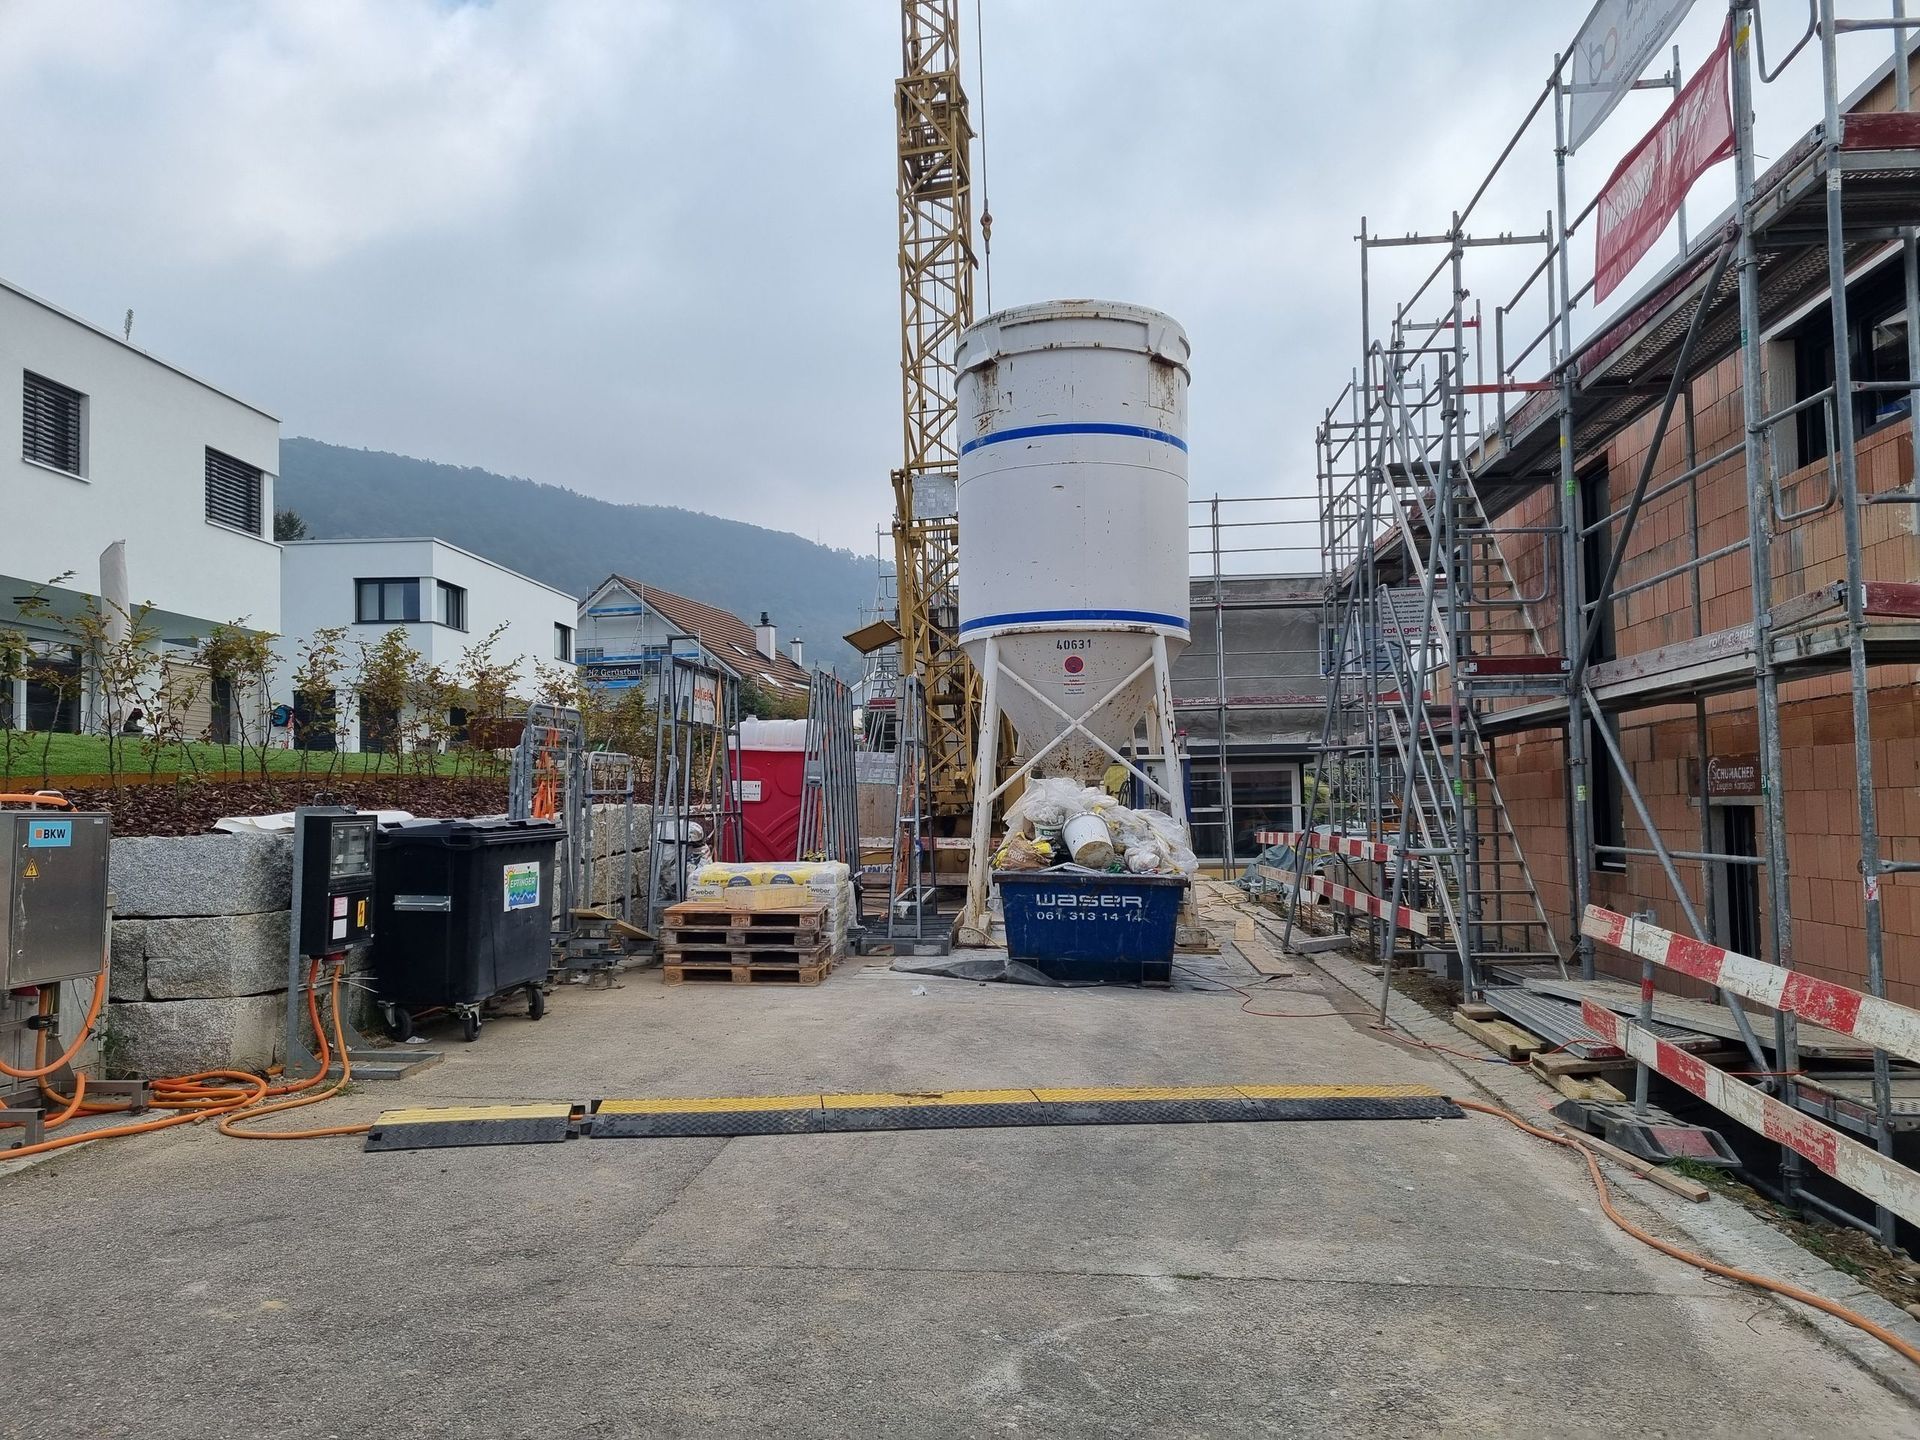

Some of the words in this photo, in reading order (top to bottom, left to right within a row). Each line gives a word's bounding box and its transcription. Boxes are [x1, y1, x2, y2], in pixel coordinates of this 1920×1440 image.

[1056, 639, 1092, 650] 40631
[43, 829, 66, 839] BKW
[811, 887, 831, 895] weber
[1036, 911, 1061, 920] 061
[1069, 912, 1096, 921] 313
[1102, 912, 1119, 921] 14
